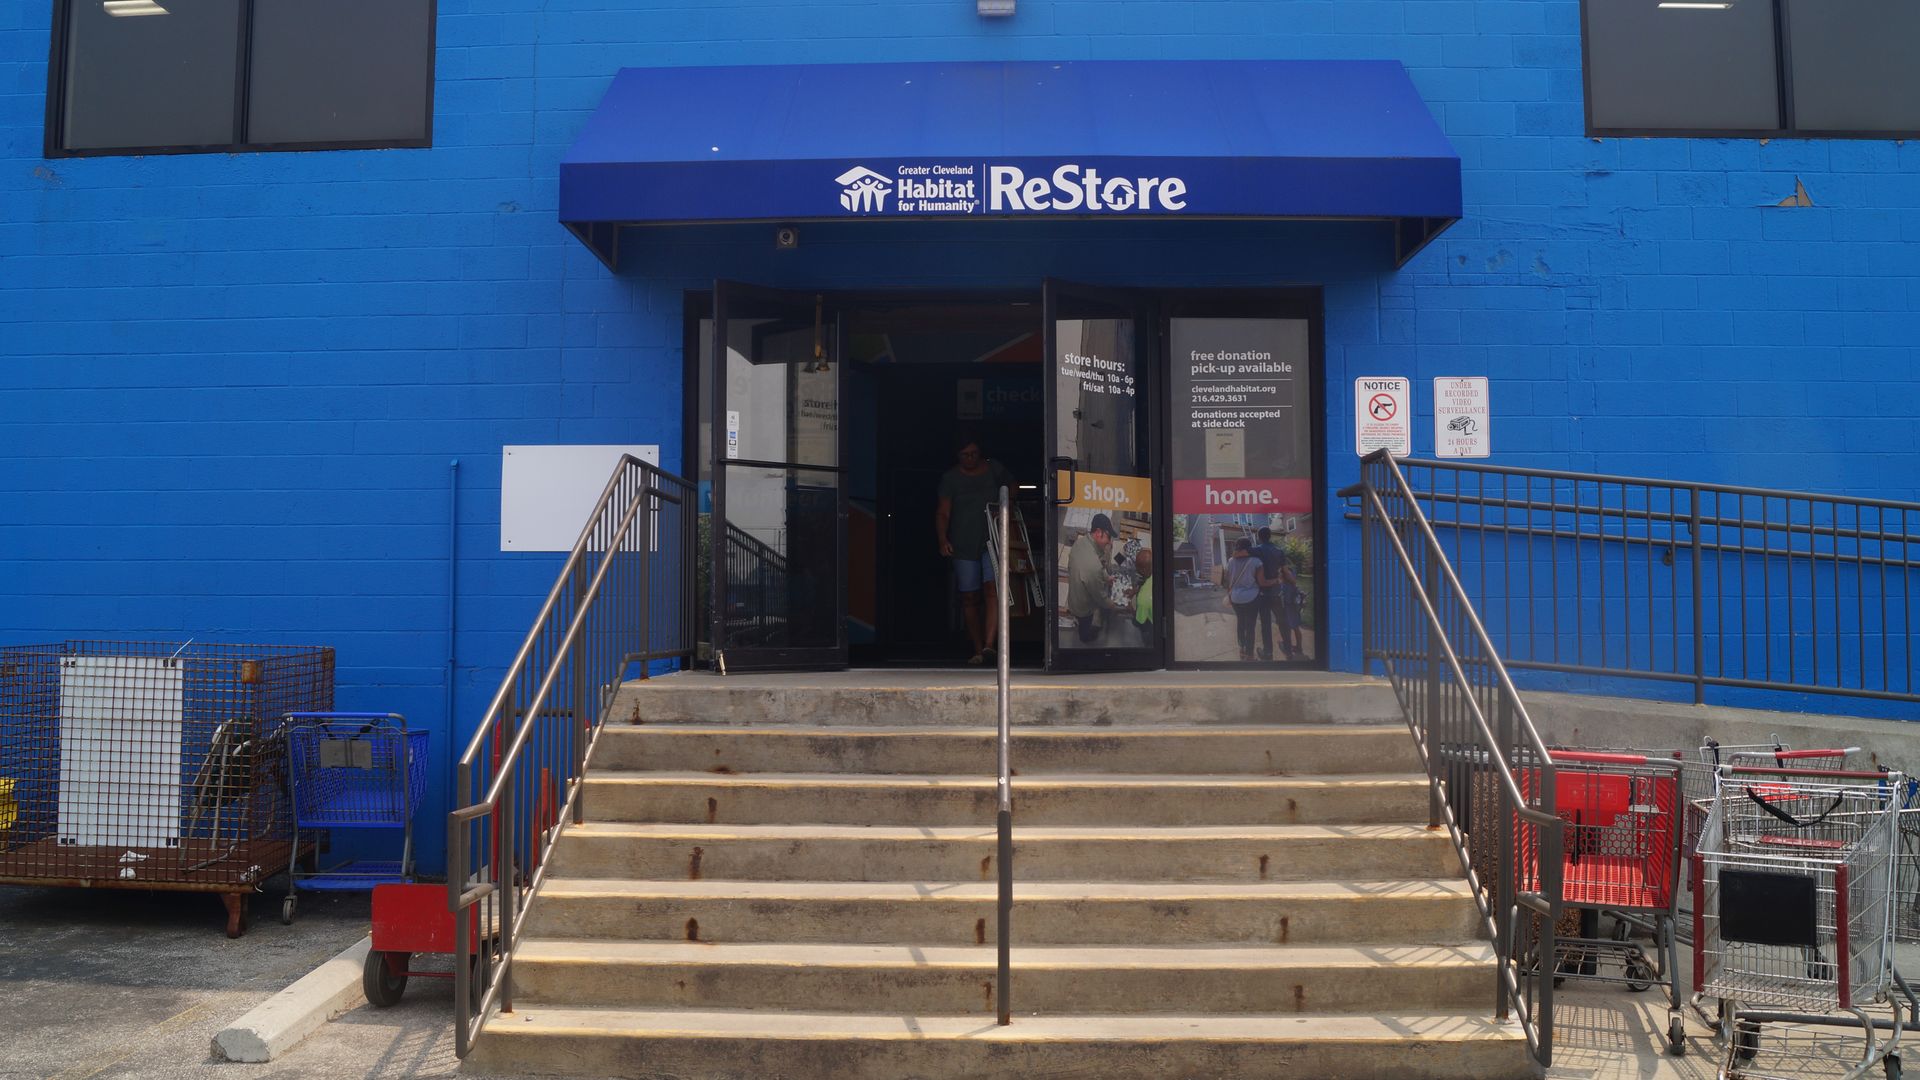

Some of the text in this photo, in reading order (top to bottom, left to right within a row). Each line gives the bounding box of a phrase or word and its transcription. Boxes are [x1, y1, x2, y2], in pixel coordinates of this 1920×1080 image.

[898, 165, 973, 175] Greater Cleveland
[898, 178, 975, 198] Habitat
[990, 164, 1187, 211] ReStore
[898, 200, 914, 211] for
[1191, 350, 1271, 361] free donation
[1064, 352, 1125, 372] store hours:
[1061, 366, 1104, 382] tue/wed/thu
[1191, 362, 1292, 375] pick-up available
[1083, 381, 1104, 393] fri/sat
[1191, 385, 1276, 394] clevelandhabitat.org
[1364, 382, 1401, 390] NOTICE
[1191, 409, 1281, 420] donations accepted
[1191, 419, 1246, 428] at side dock
[1083, 480, 1130, 507] shop.
[1205, 484, 1279, 505] home.
